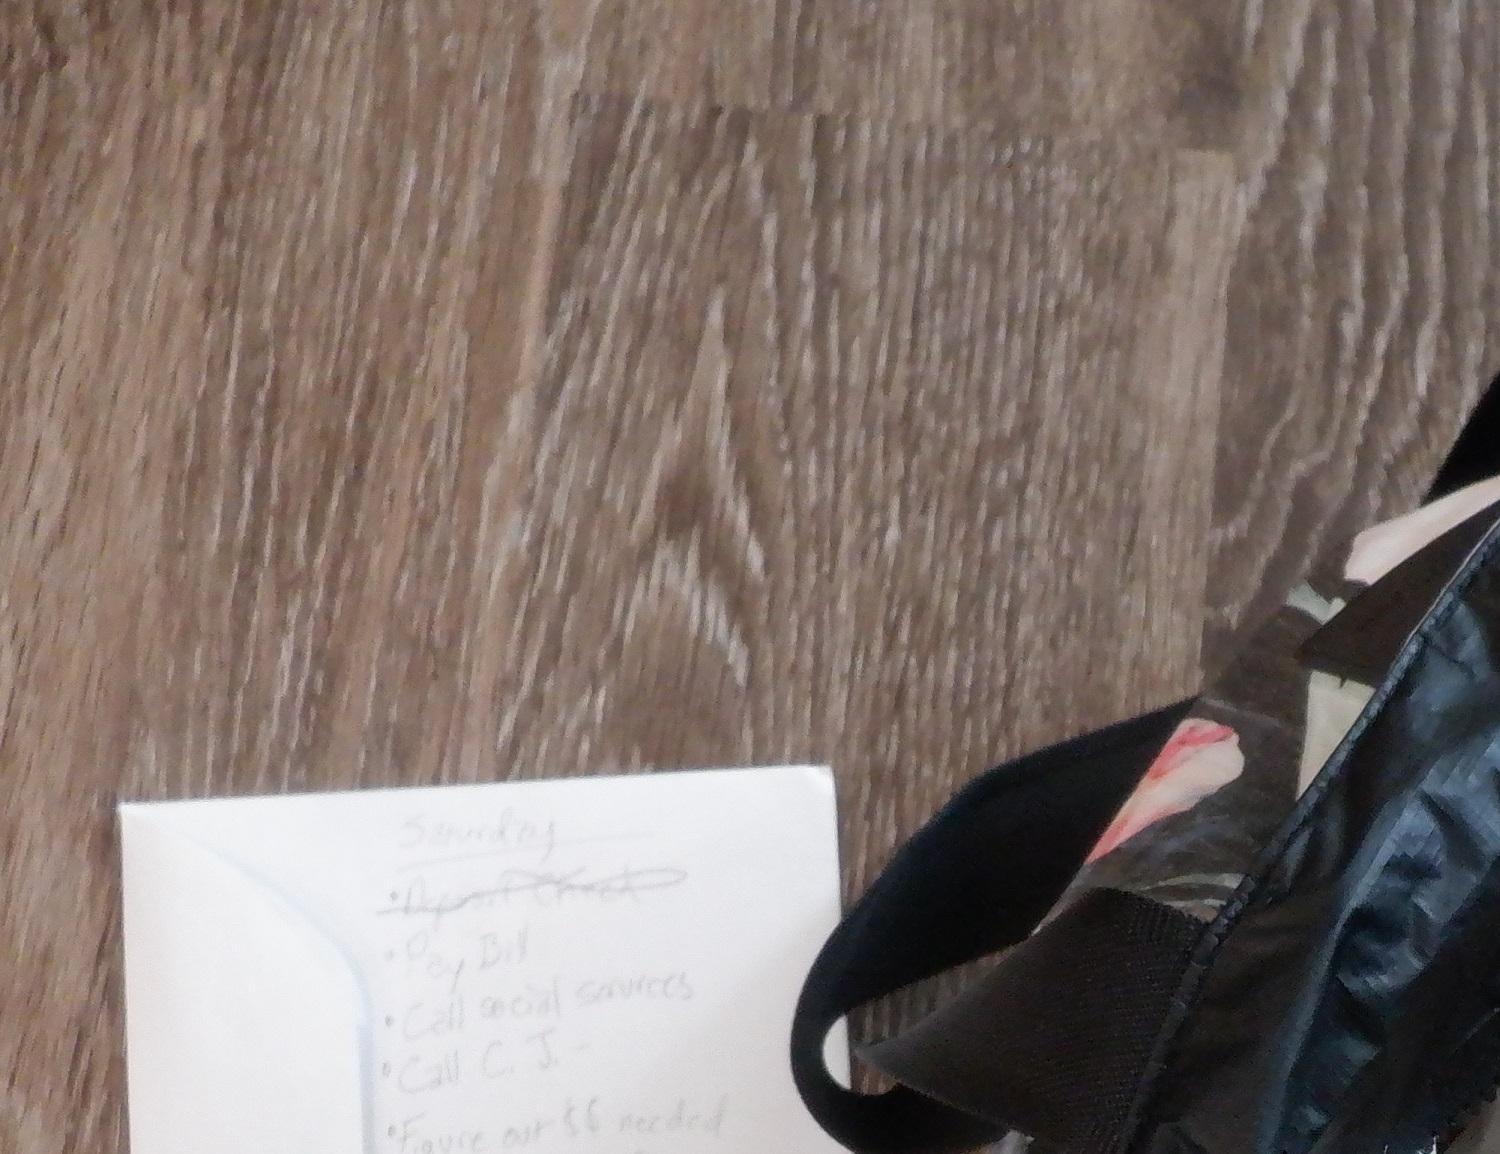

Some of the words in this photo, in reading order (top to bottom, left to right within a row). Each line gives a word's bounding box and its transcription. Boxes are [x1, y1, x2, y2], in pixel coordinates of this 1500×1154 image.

[405, 930, 465, 993] Pay
[402, 997, 465, 1040] Call
[399, 1048, 459, 1093] Call
[619, 1094, 727, 1136] needed
